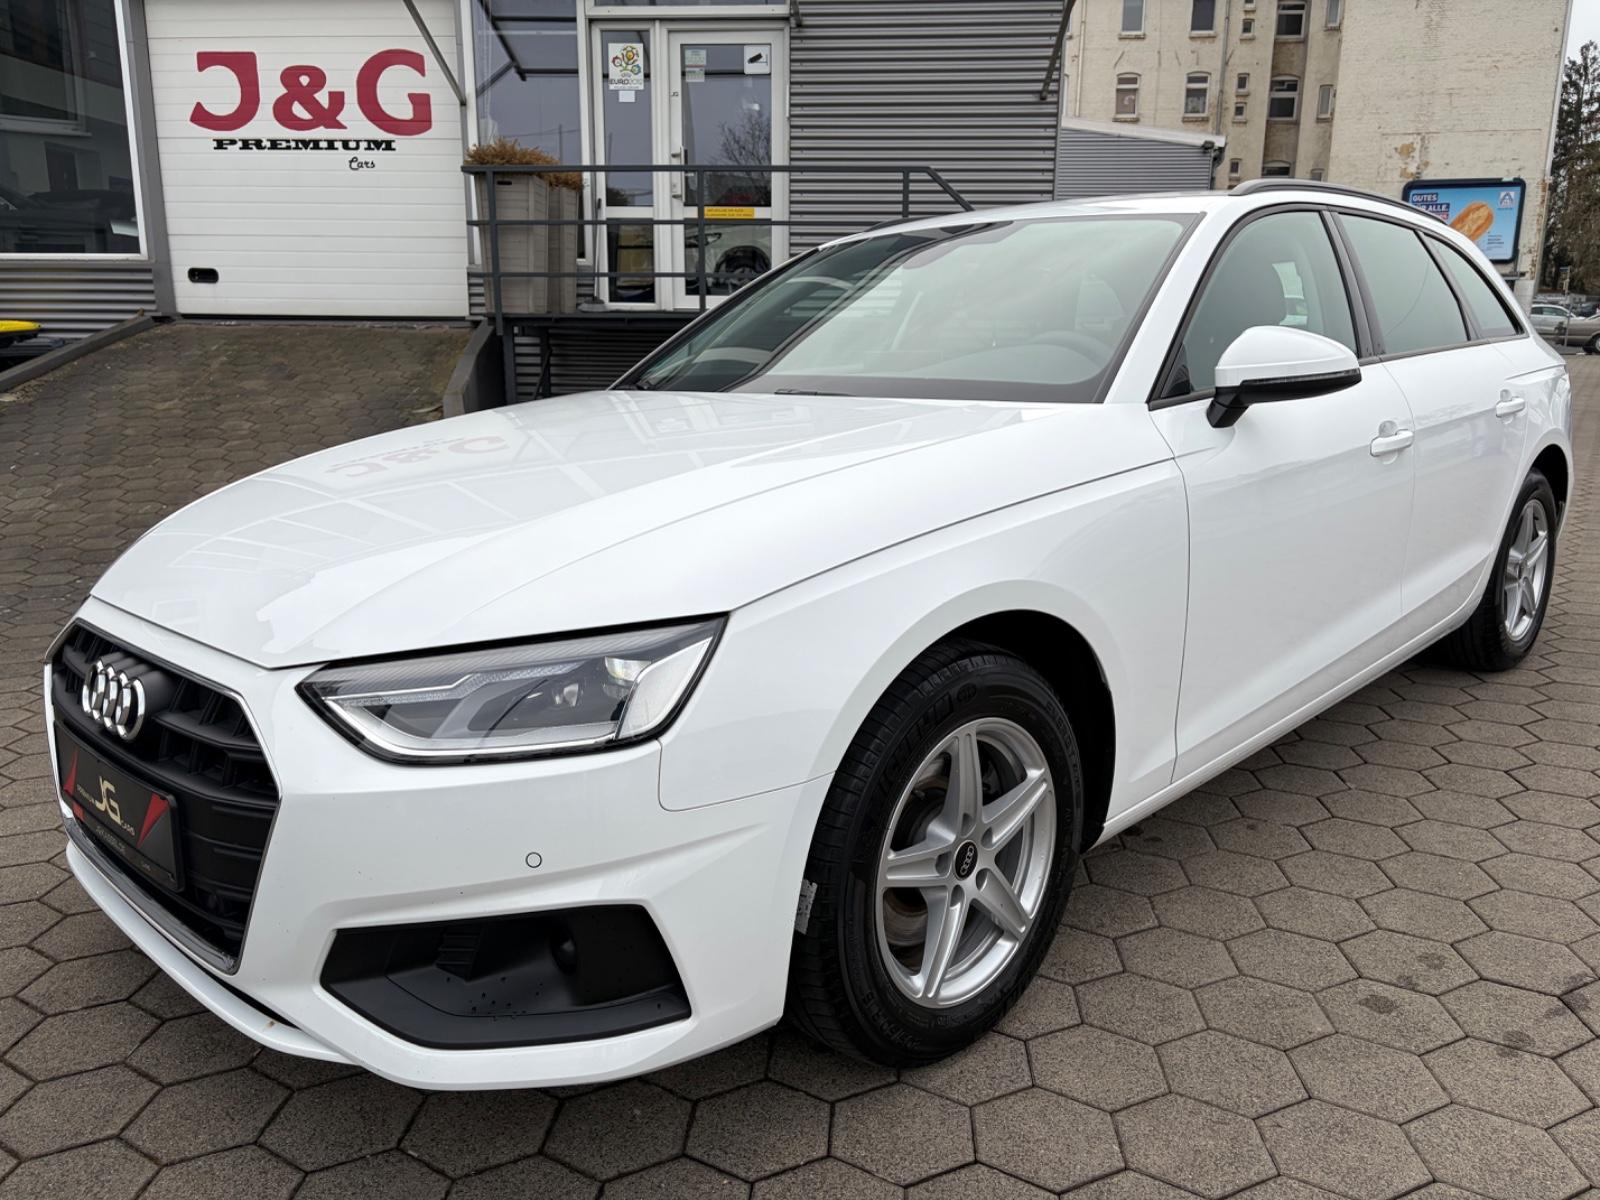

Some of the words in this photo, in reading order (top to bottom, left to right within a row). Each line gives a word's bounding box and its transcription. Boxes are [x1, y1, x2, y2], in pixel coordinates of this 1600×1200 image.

[190, 49, 433, 136] J&G
[213, 139, 396, 151] PREMIUM
[348, 156, 376, 171] Cars
[1412, 194, 1437, 202] GUTES
